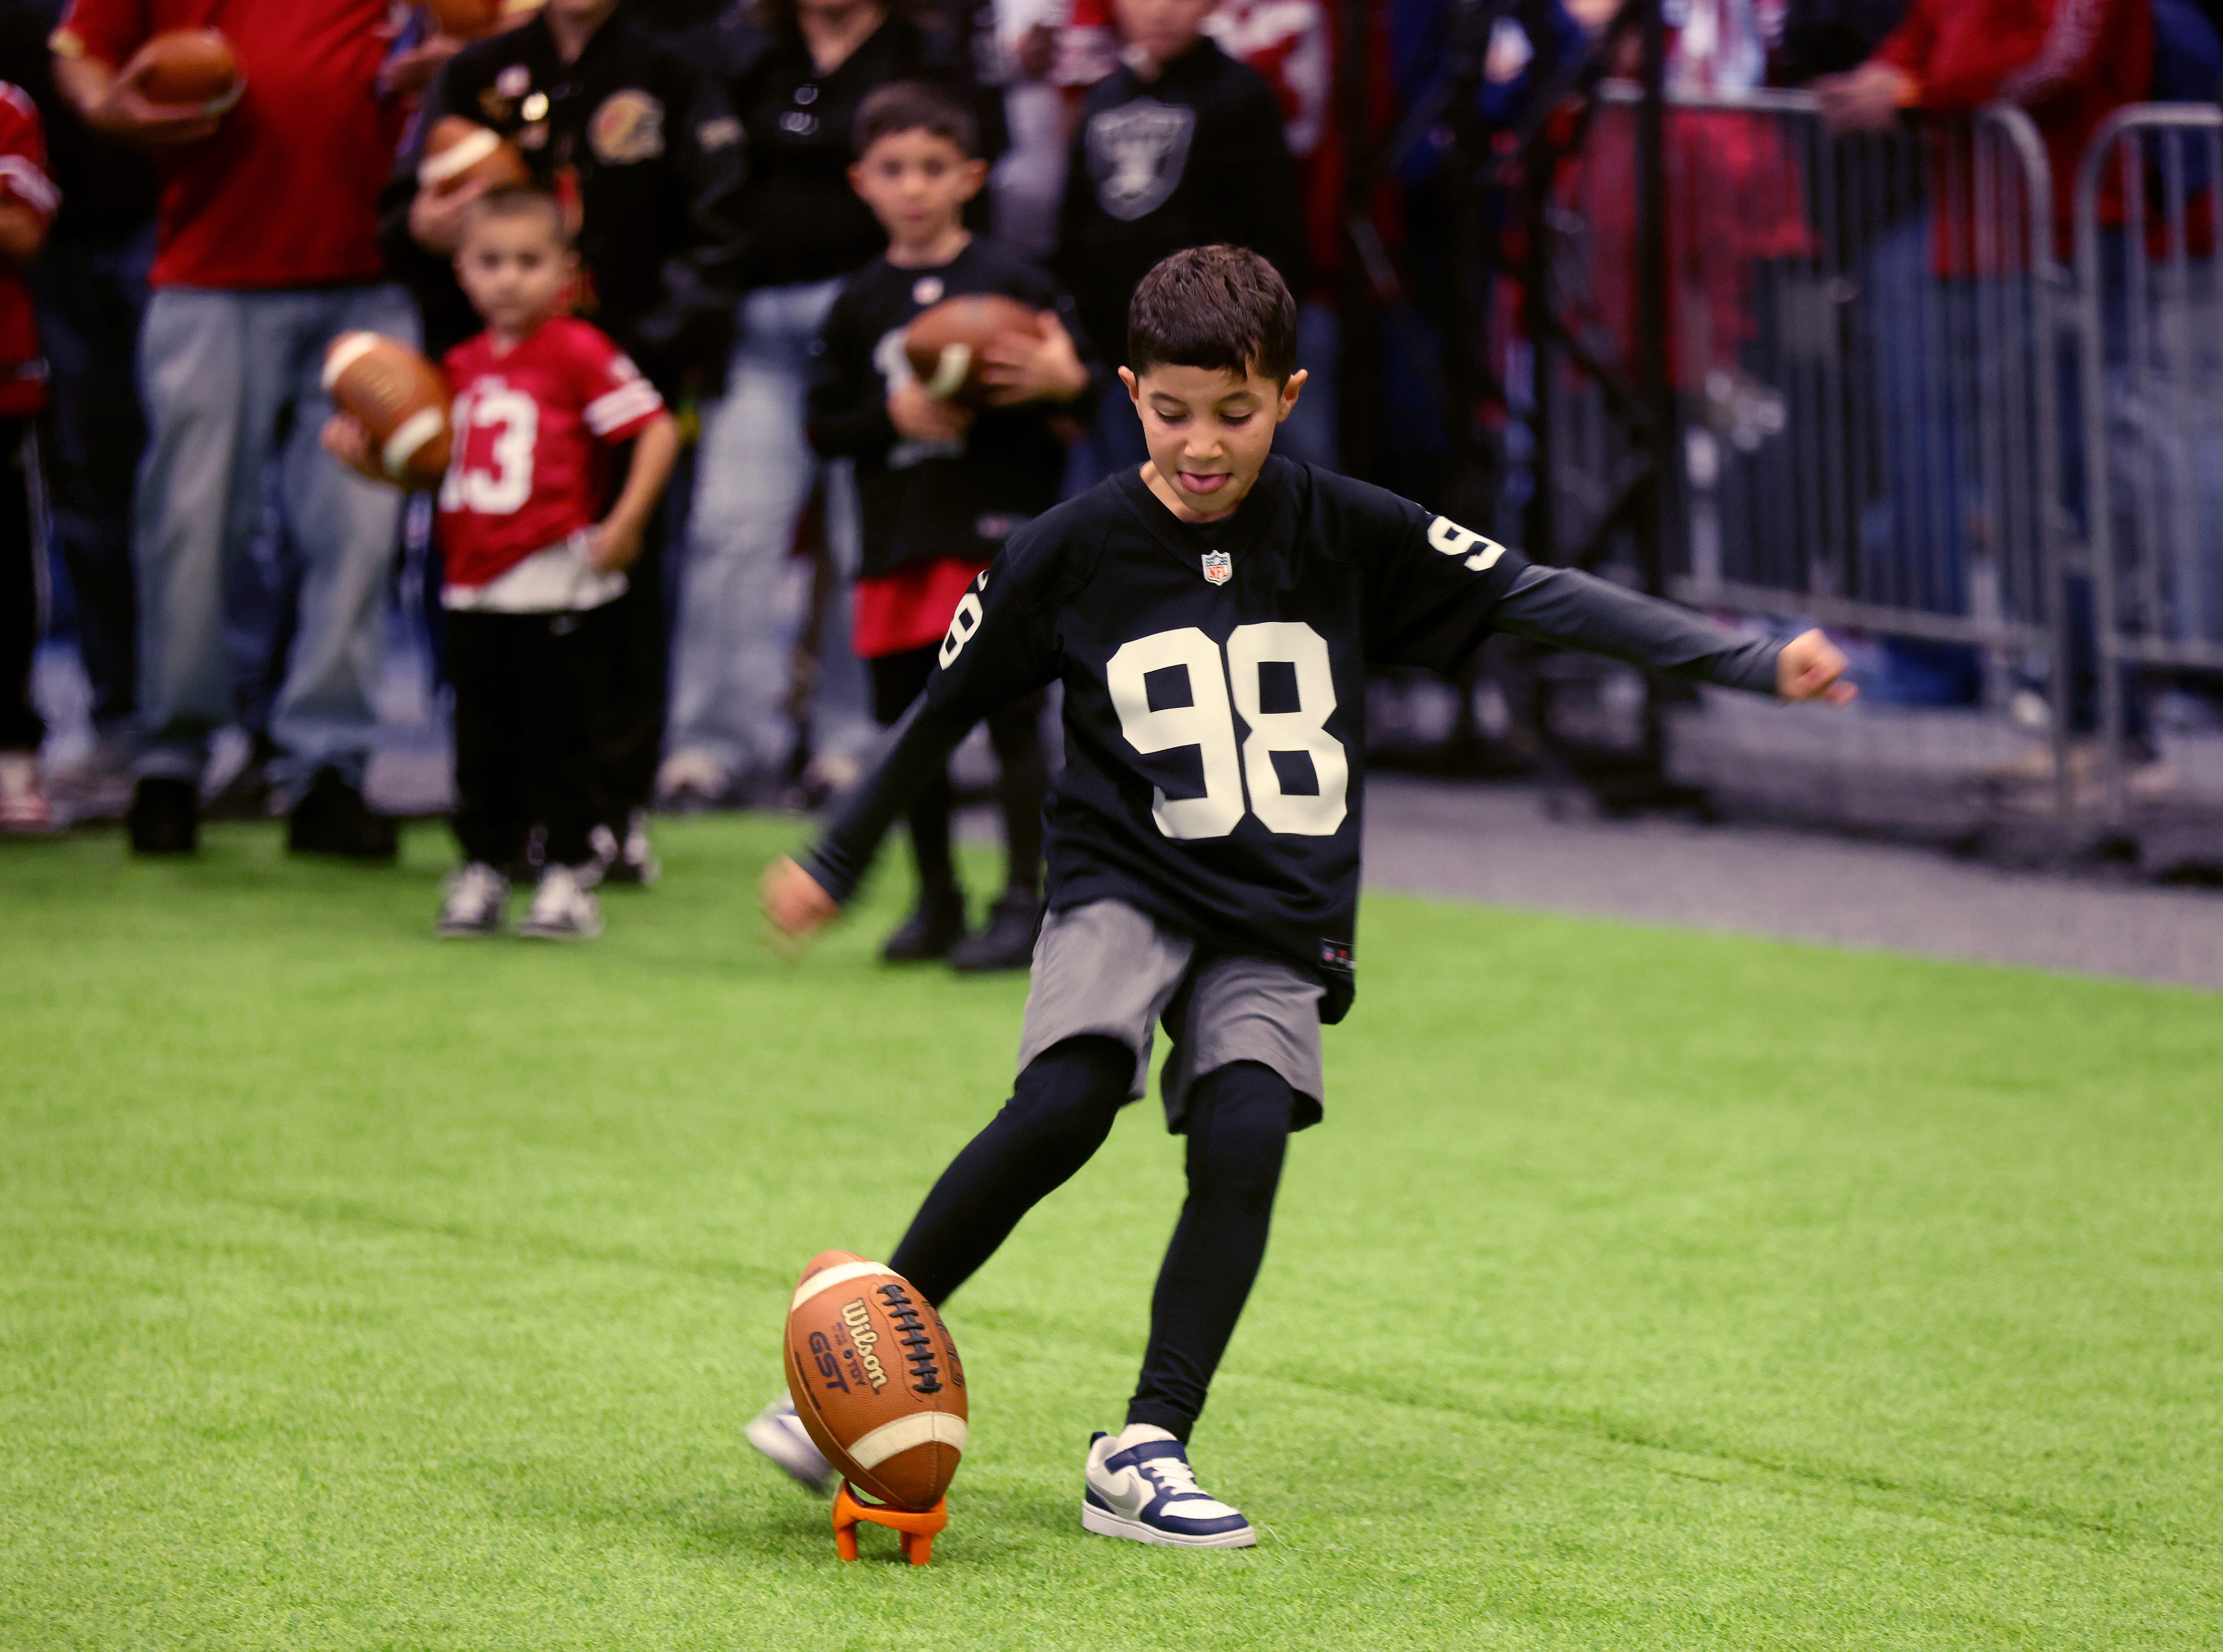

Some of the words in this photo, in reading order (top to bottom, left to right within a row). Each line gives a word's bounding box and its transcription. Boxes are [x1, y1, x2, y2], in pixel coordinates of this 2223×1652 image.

[1208, 565, 1228, 580] NFL
[1106, 622, 1348, 840] 98
[809, 1331, 850, 1394] GST
[841, 1298, 888, 1391] Wilson
